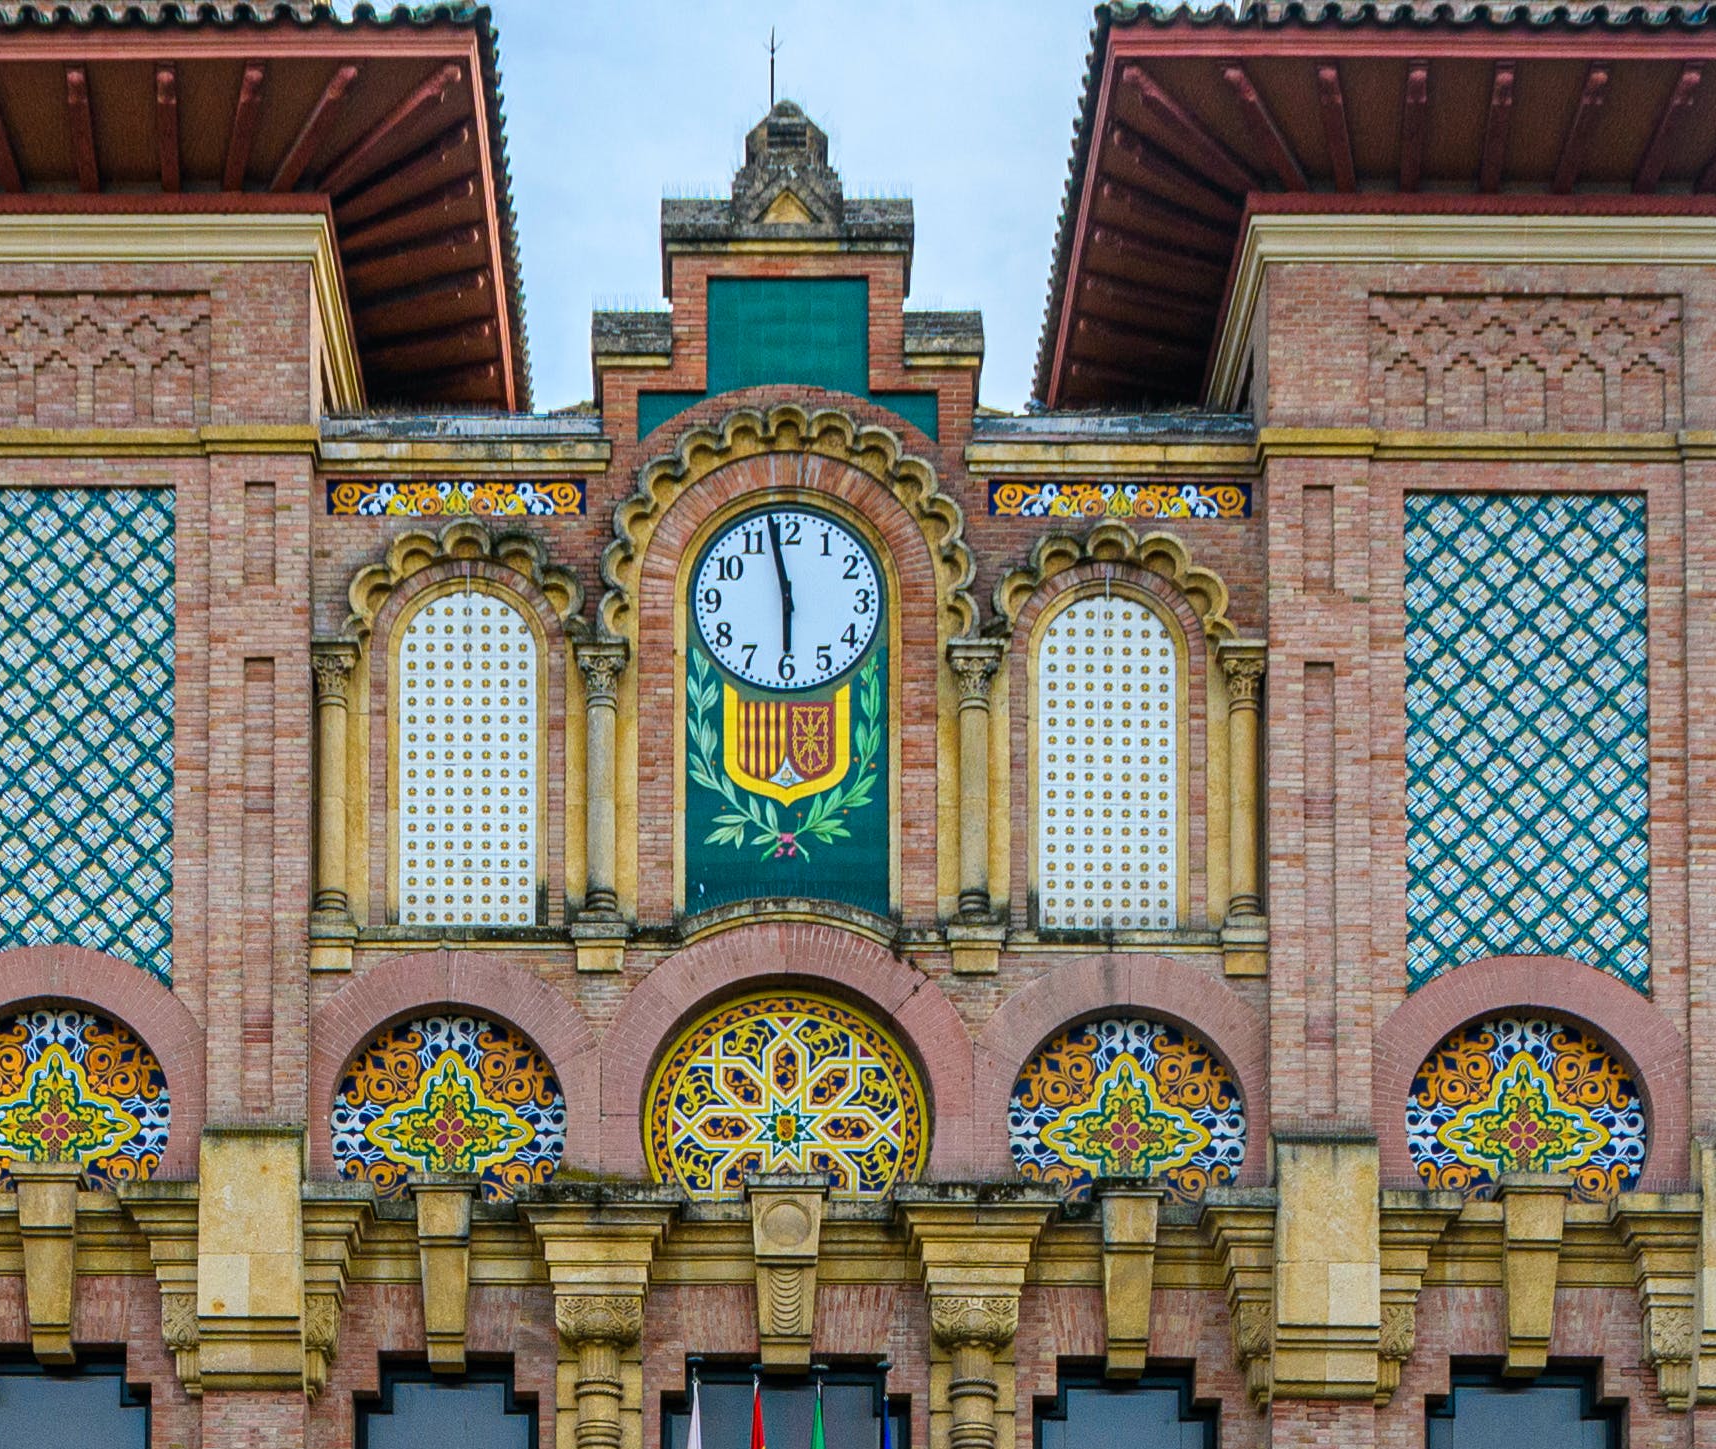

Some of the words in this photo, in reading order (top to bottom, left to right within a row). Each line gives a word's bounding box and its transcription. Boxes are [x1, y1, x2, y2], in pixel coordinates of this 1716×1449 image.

[742, 530, 765, 555] 11
[774, 520, 802, 546] 12
[820, 532, 832, 557] 1
[716, 555, 744, 581] 10
[842, 554, 861, 580] 2
[704, 588, 722, 614] 9
[853, 588, 870, 614] 3
[715, 621, 733, 648] 8
[840, 622, 858, 649] 4
[740, 643, 758, 670] 7
[777, 653, 796, 680] 6
[815, 643, 832, 671] 5
